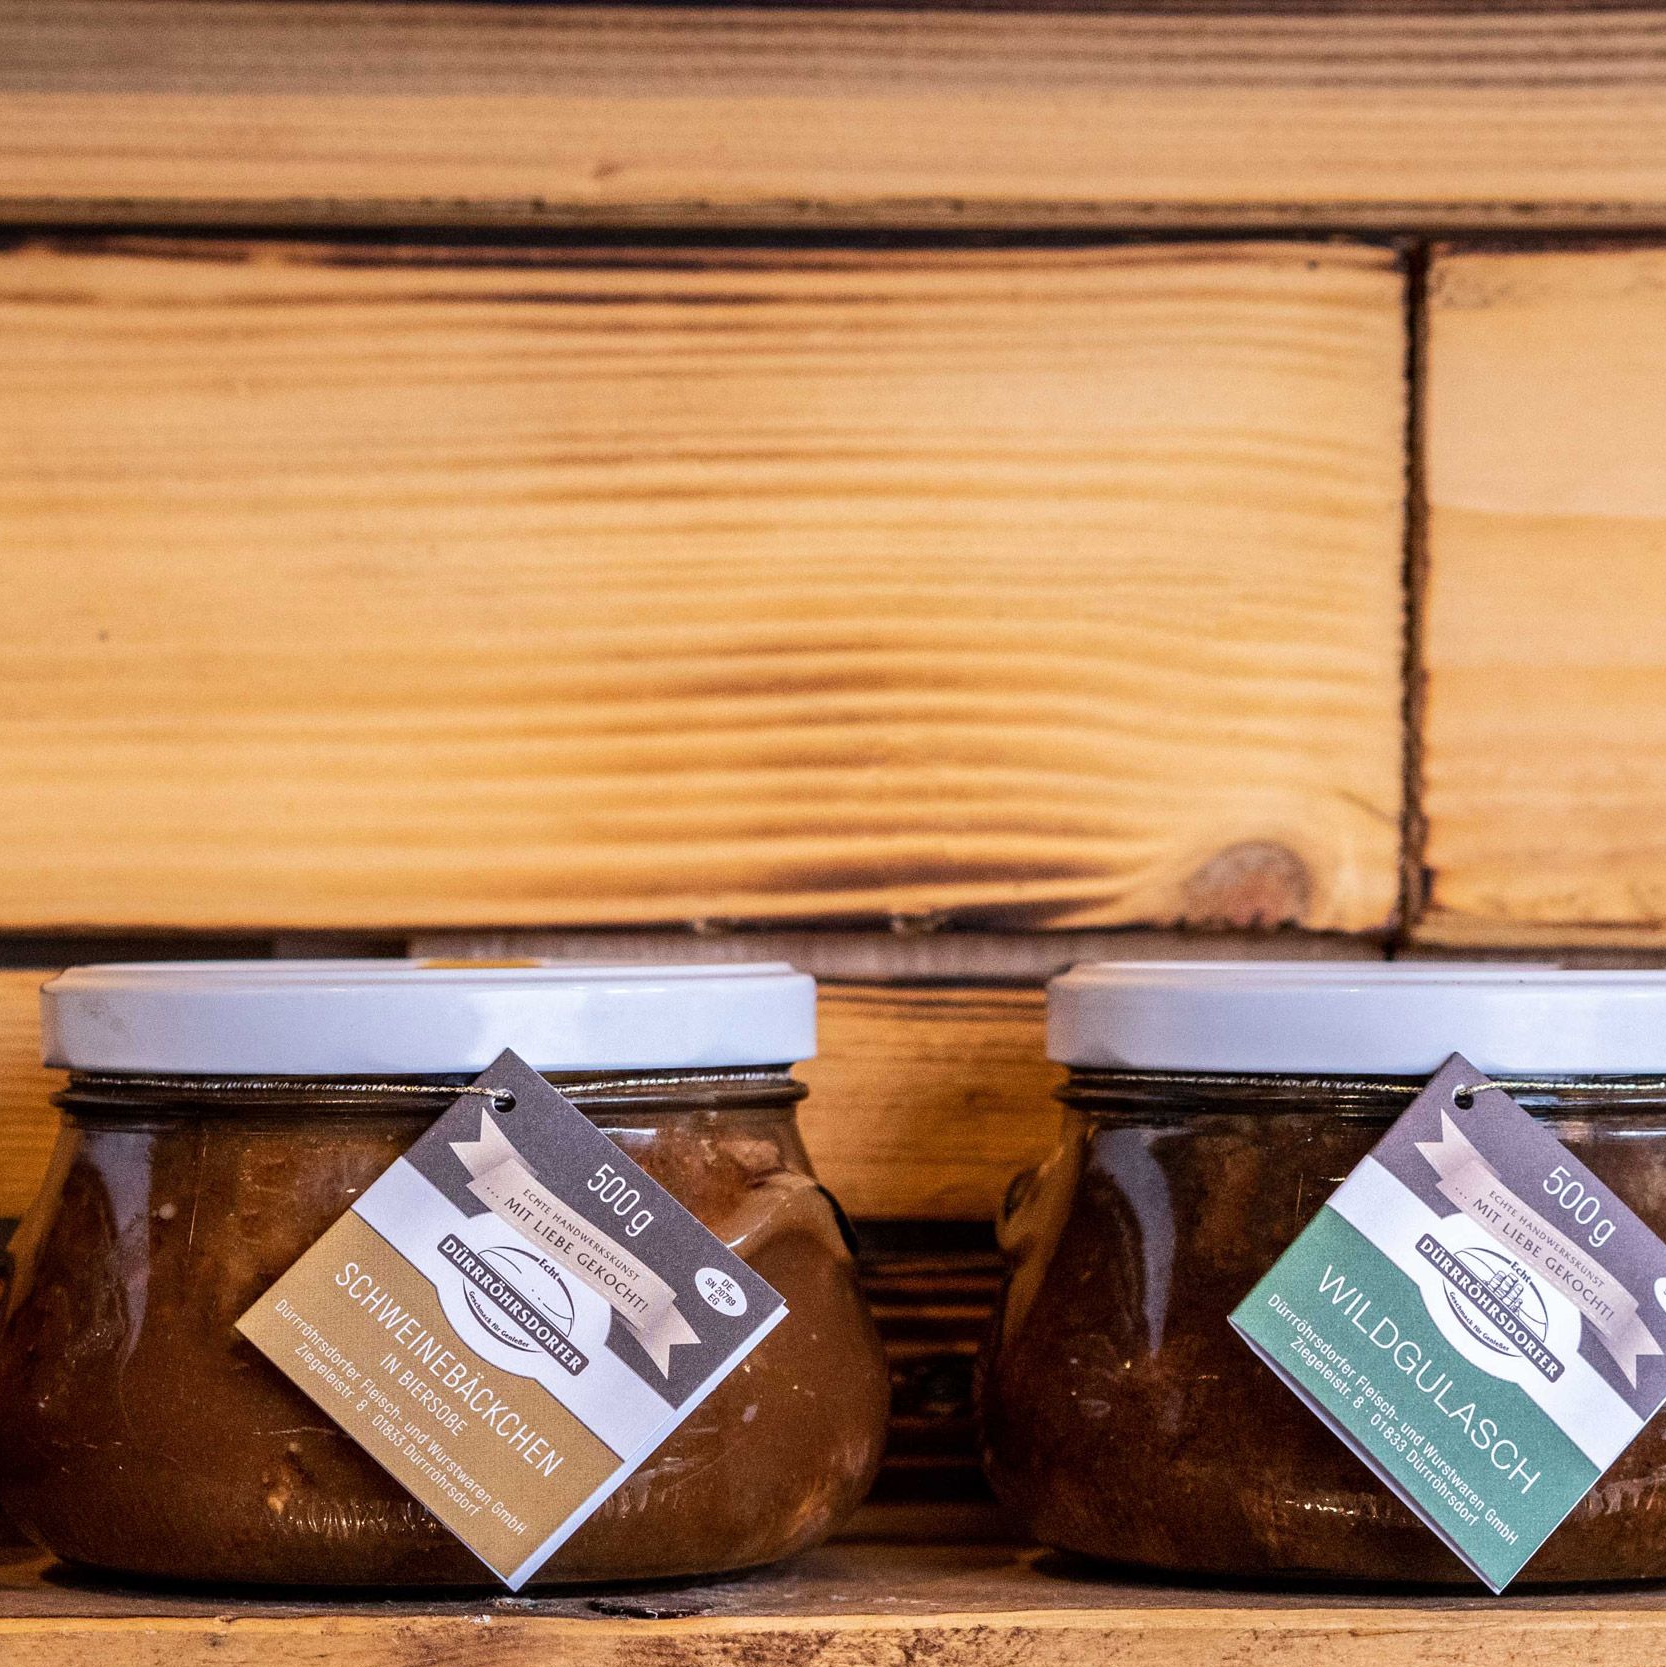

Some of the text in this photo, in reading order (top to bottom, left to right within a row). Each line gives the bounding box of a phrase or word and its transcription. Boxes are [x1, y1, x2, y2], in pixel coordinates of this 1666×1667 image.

[503, 1197, 534, 1222] MIT
[533, 1219, 575, 1255] LIEBE
[576, 1252, 649, 1314] GEKOCHT!
[522, 1188, 640, 1281] ECHTE HANDWERKSKUNST
[538, 1258, 560, 1280] Echt
[721, 1278, 735, 1292] DE
[1472, 1198, 1501, 1224] MIT
[1502, 1222, 1542, 1259] LIEBE
[1544, 1256, 1615, 1322] GEKOCHT!
[1488, 1190, 1605, 1288] ECHTE HANDWERKSKUNST
[1510, 1261, 1532, 1284] Echt
[441, 1238, 588, 1371] DÜRRRÖHRSDORFER
[467, 1290, 492, 1324] Geschmack
[704, 1277, 737, 1307] SN 20789
[707, 1293, 721, 1306] EG
[1419, 1234, 1563, 1378] DÜRRRÖHRSDORFER
[1471, 1324, 1483, 1336] für
[274, 1298, 528, 1536] Dürrröhrsdorfer Fleisch- und Wurstwaren GmbH
[335, 1262, 564, 1478] SCHWEINEBÄCKCHEN
[379, 1352, 402, 1375] IN
[1318, 1264, 1541, 1495] WILDGULASCH
[294, 1341, 355, 1403] Ziegeleistr.
[355, 1398, 369, 1412] 8
[371, 1414, 407, 1448] 01833
[402, 1442, 482, 1517] Dürrröhrsdorf
[1267, 1293, 1519, 1546] Dürrröhrsdorfer Fleisch- und Wurstwaren GmbH
[1290, 1335, 1352, 1400] Ziegeleistr.
[1352, 1395, 1365, 1409] 8
[1370, 1412, 1408, 1453] 01833
[1405, 1448, 1480, 1527] Dürrröhrsdorf
